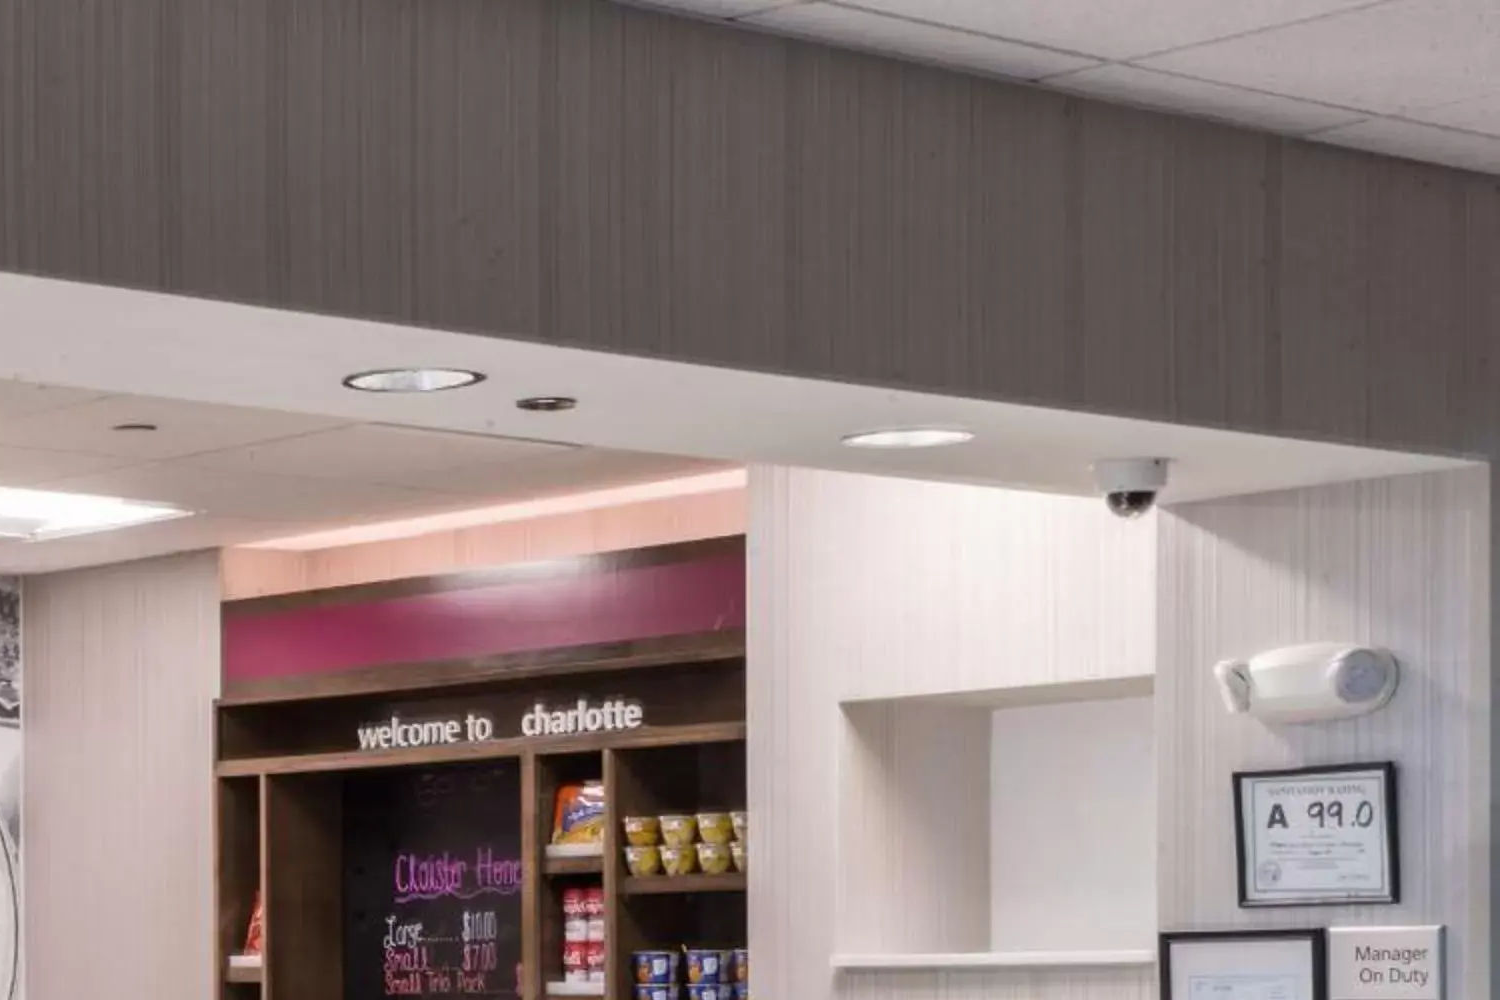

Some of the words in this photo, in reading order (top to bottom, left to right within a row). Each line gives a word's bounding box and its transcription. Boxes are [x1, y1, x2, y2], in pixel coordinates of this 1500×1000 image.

[357, 716, 461, 749] welcome
[466, 714, 493, 742] to
[521, 700, 643, 737] charlotte
[1267, 803, 1289, 829] A
[1354, 946, 1428, 971] Manager
[1359, 968, 1384, 983] On
[1389, 967, 1429, 987] Duty
